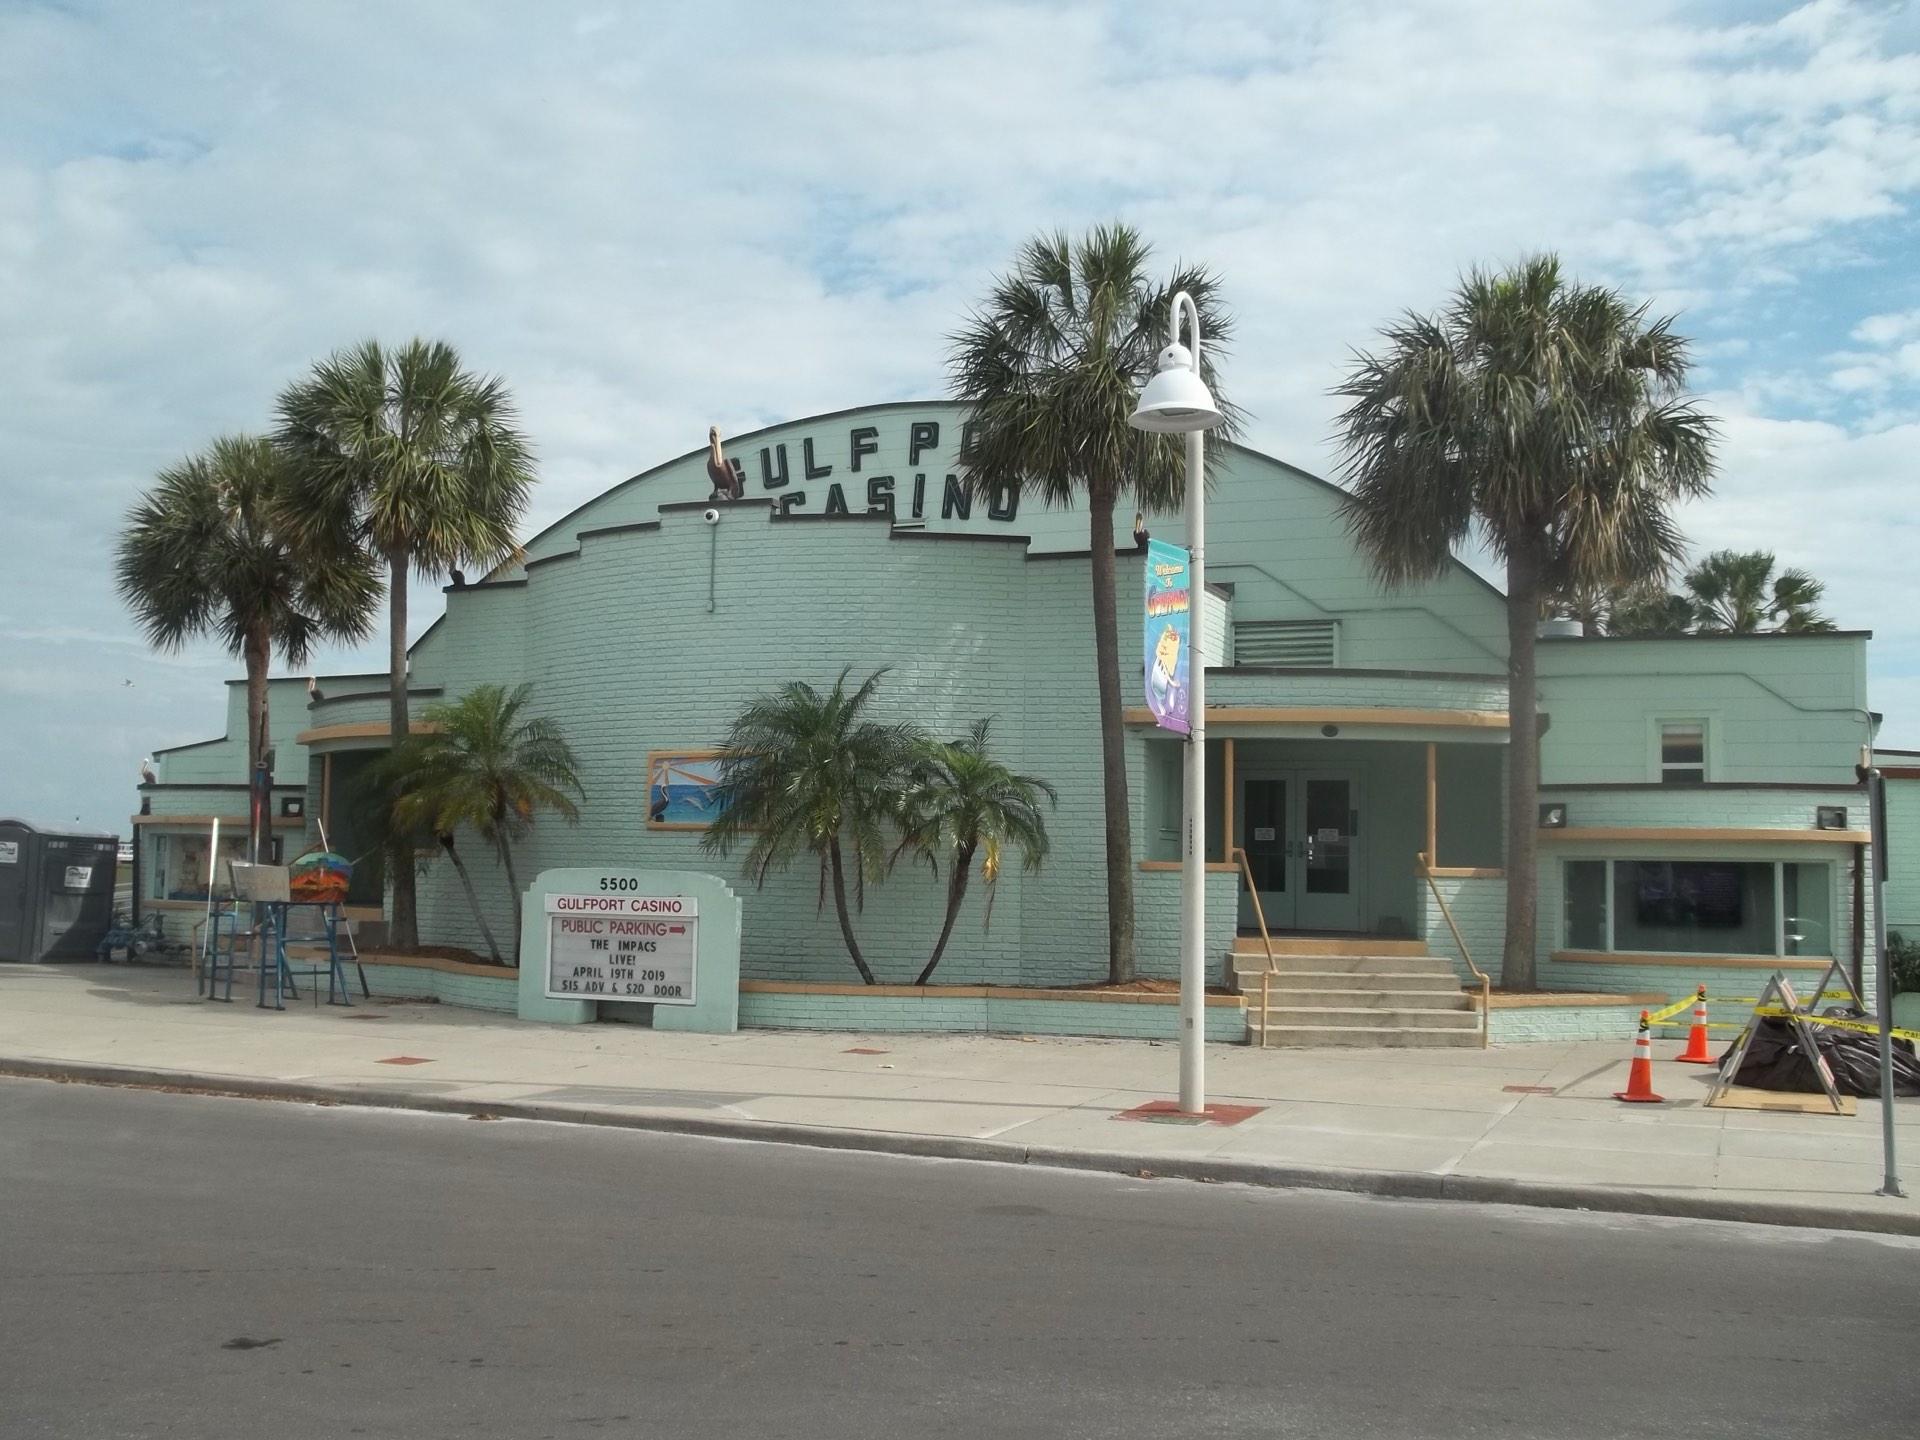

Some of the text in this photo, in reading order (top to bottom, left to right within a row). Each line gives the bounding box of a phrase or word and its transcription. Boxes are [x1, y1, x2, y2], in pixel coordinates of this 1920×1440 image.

[600, 877, 638, 890] 5500
[557, 898, 682, 913] GULFPORT CASINO
[561, 919, 667, 936] PUBLIC PARKING
[590, 939, 657, 952] THE IMPACS
[609, 954, 636, 966] LIVE!
[573, 967, 665, 981] APRIL 19TH 2019
[585, 981, 605, 993] ADV
[612, 982, 618, 993] &
[654, 984, 682, 997] DOOR
